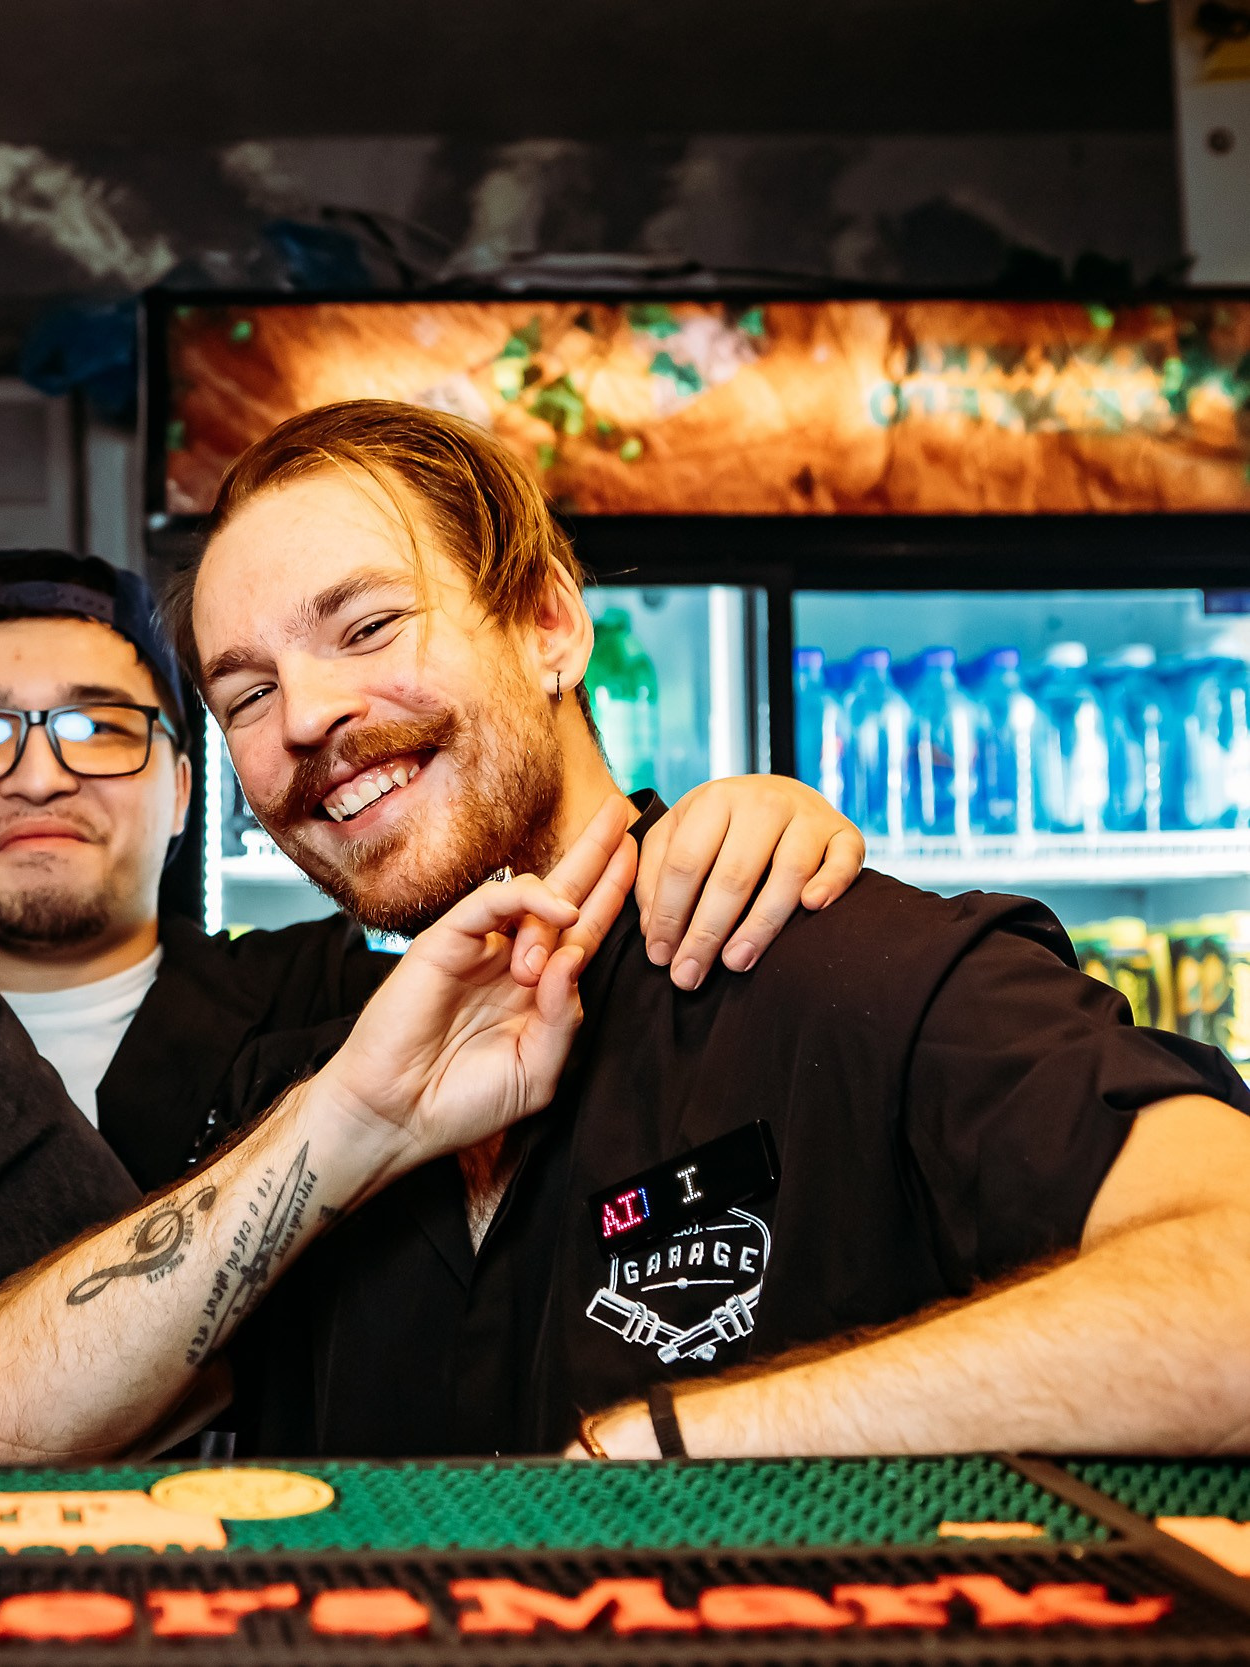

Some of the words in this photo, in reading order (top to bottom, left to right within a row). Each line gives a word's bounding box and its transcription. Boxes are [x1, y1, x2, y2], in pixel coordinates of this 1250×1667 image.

[677, 1166, 702, 1203] I
[623, 1241, 760, 1285] GARAGE
[450, 1573, 1173, 1636] Mark
